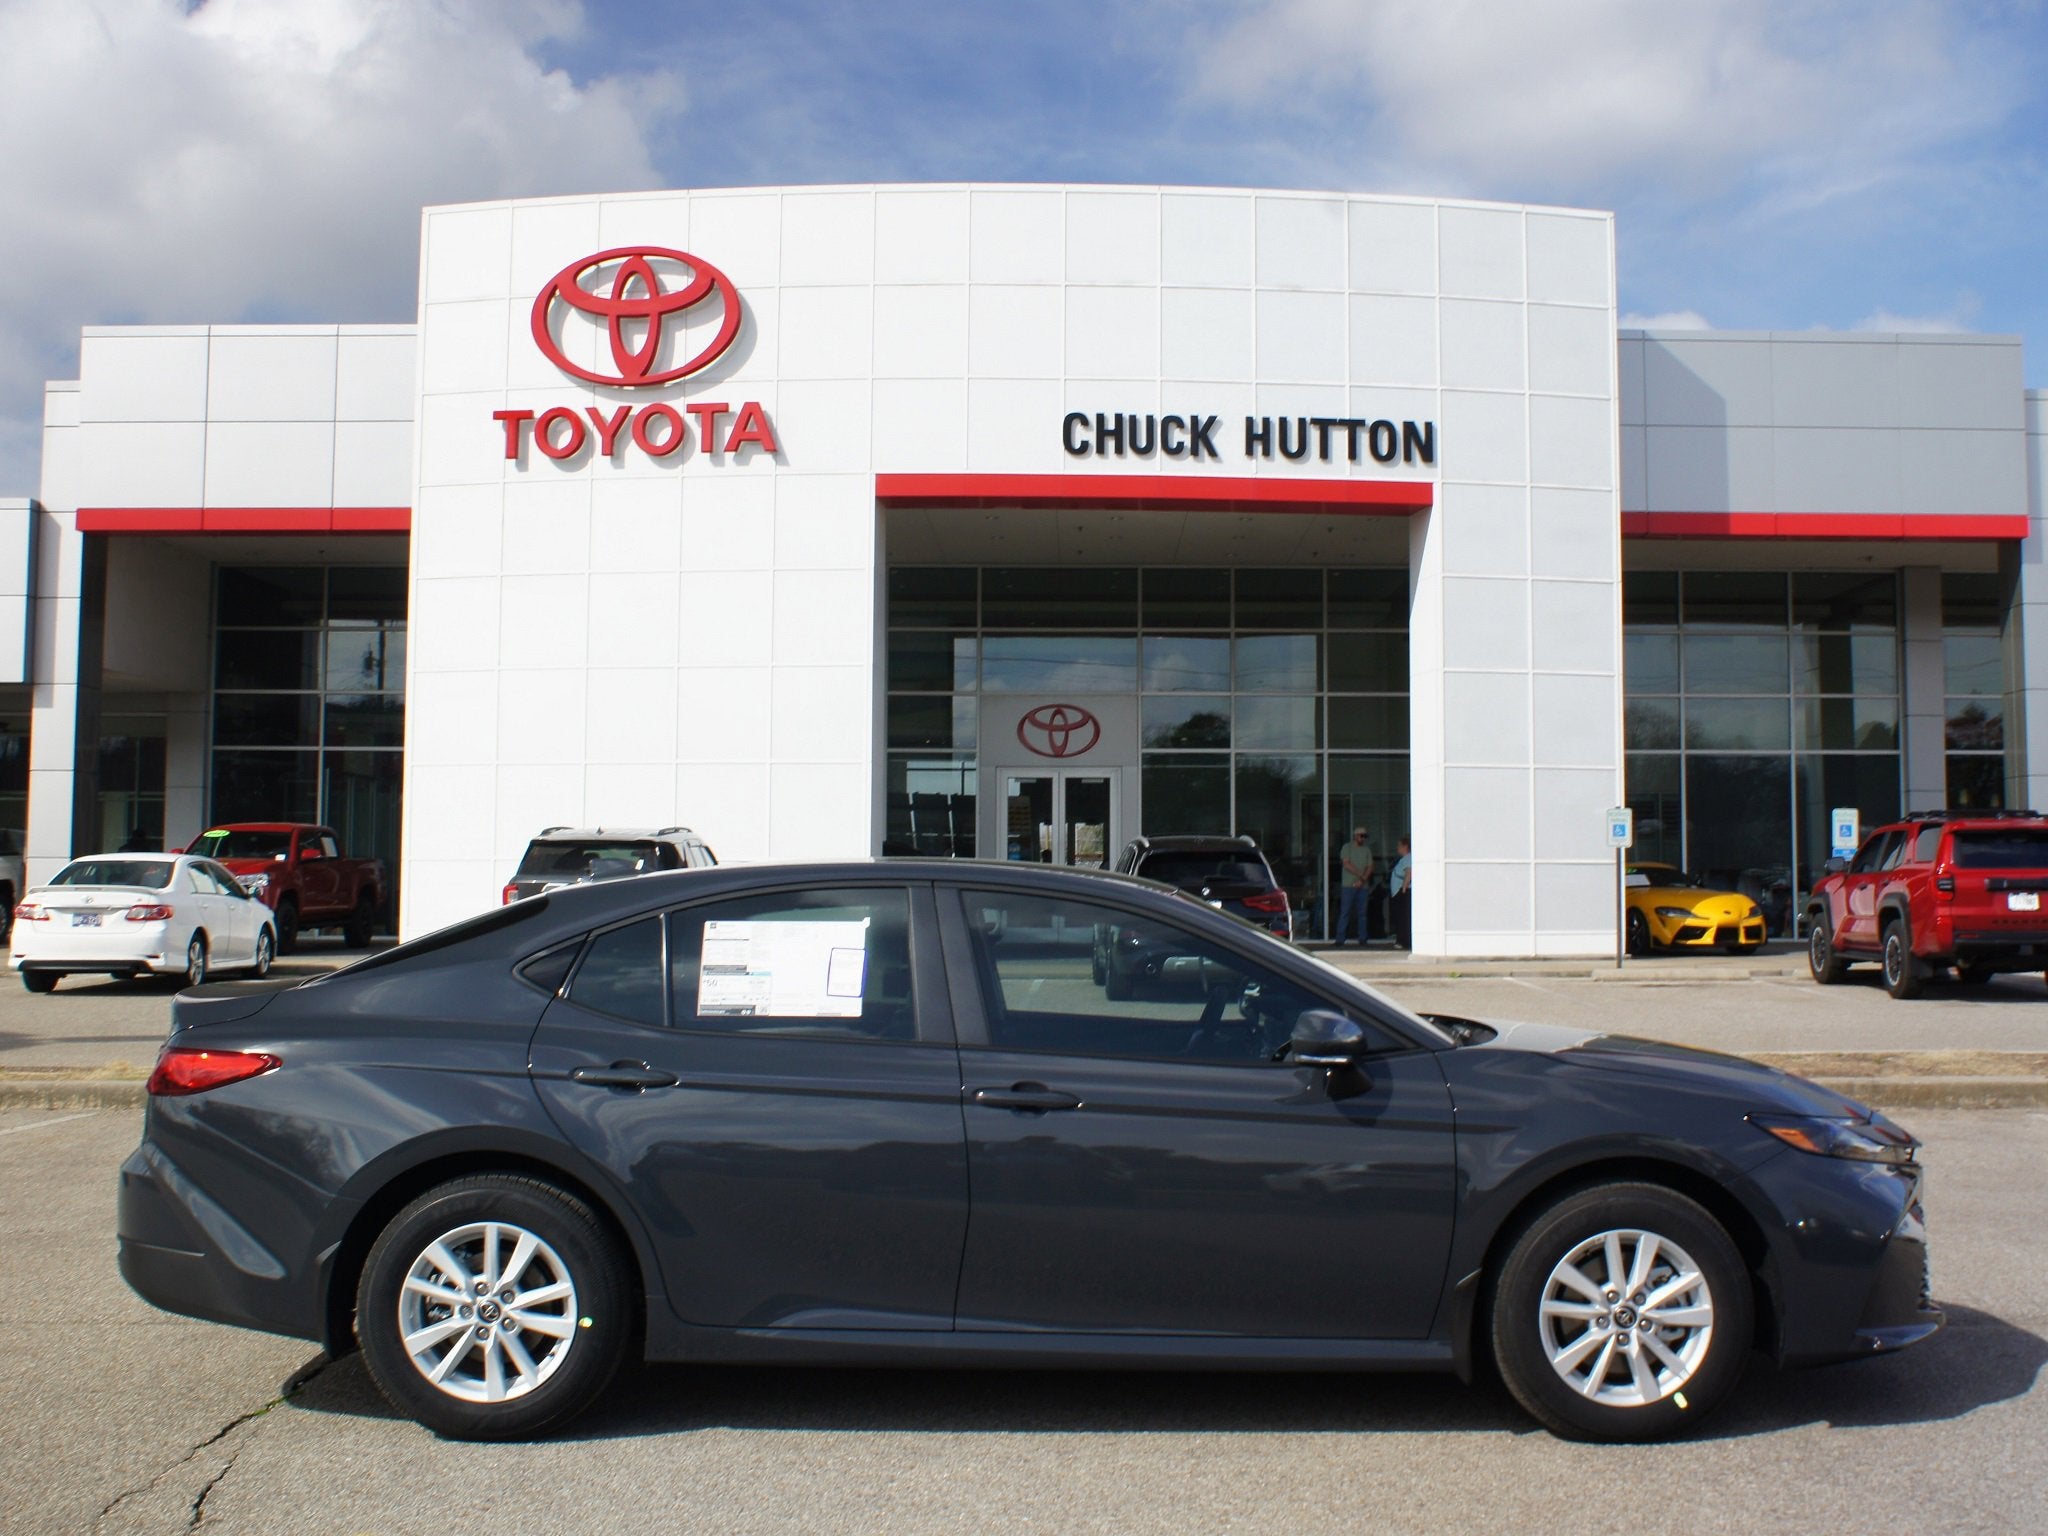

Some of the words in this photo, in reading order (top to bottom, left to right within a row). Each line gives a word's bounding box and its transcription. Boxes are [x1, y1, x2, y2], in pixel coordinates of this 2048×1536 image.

[492, 401, 777, 460] TOYOTA
[1062, 412, 1219, 458] CHUCK
[1245, 416, 1433, 463] HUTTON
